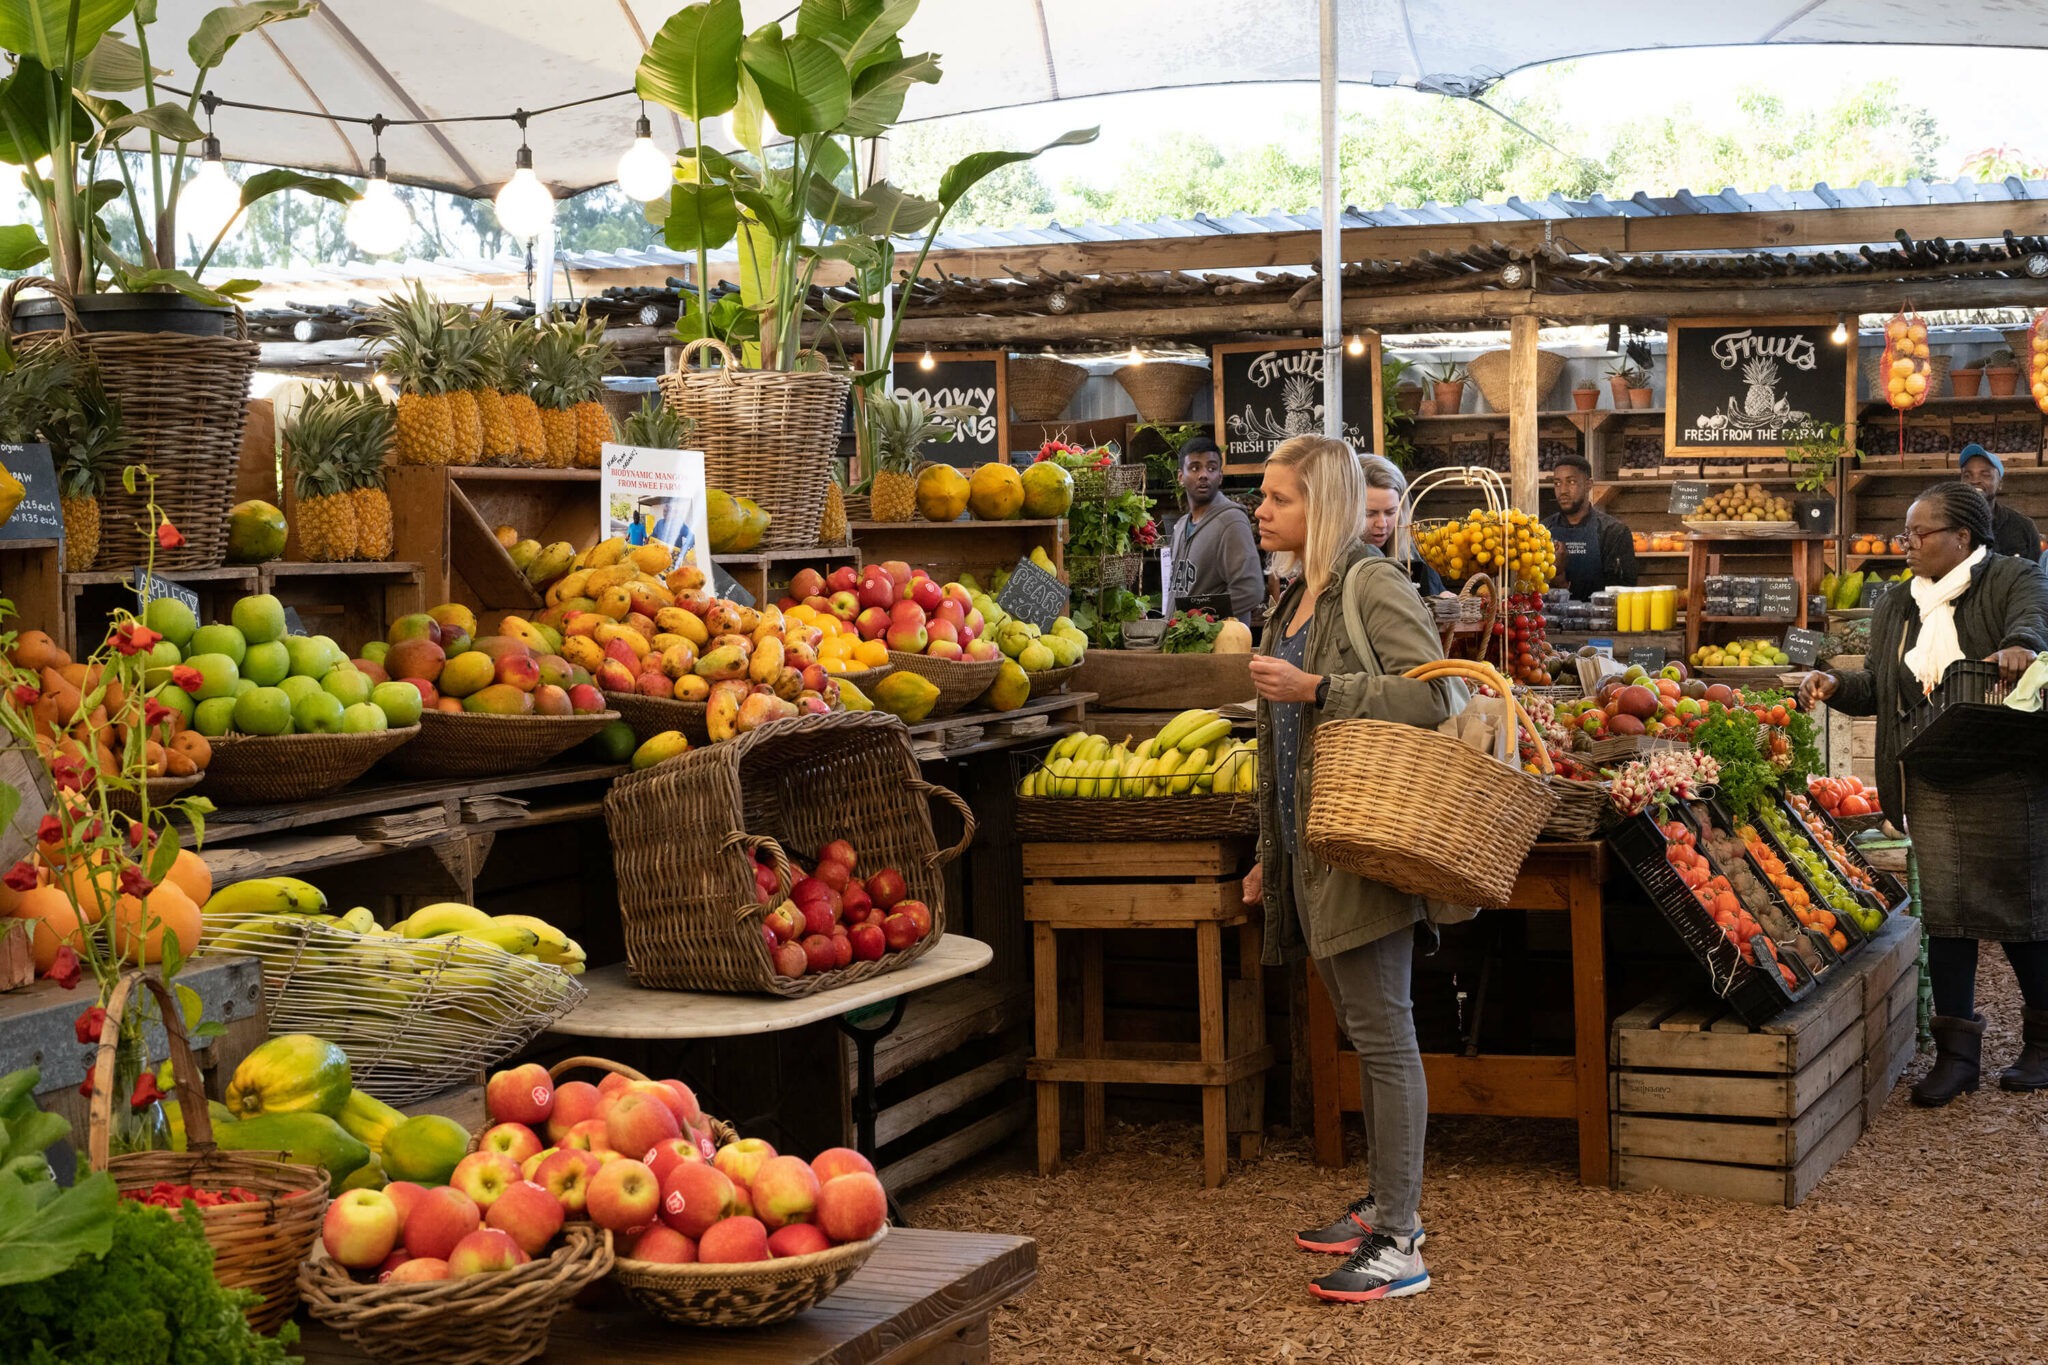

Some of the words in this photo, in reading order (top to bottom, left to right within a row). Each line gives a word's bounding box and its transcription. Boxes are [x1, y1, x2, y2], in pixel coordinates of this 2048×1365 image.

[1711, 328, 1818, 370] Fruits
[1684, 429, 1719, 441] FRESH
[1723, 428, 1752, 441] FROM
[1756, 428, 1778, 441] THE
[1781, 428, 1824, 440] FARM
[1230, 438, 1264, 454] FRESH
[1267, 438, 1282, 453] FR
[611, 468, 654, 479] BIODYNAMIC
[618, 479, 637, 489] FROM
[638, 481, 658, 490] SWEE
[38, 502, 56, 512] each
[22, 513, 38, 523] R35
[40, 516, 58, 526] each
[1168, 559, 1197, 595] AP
[1012, 568, 1063, 615] PEARS
